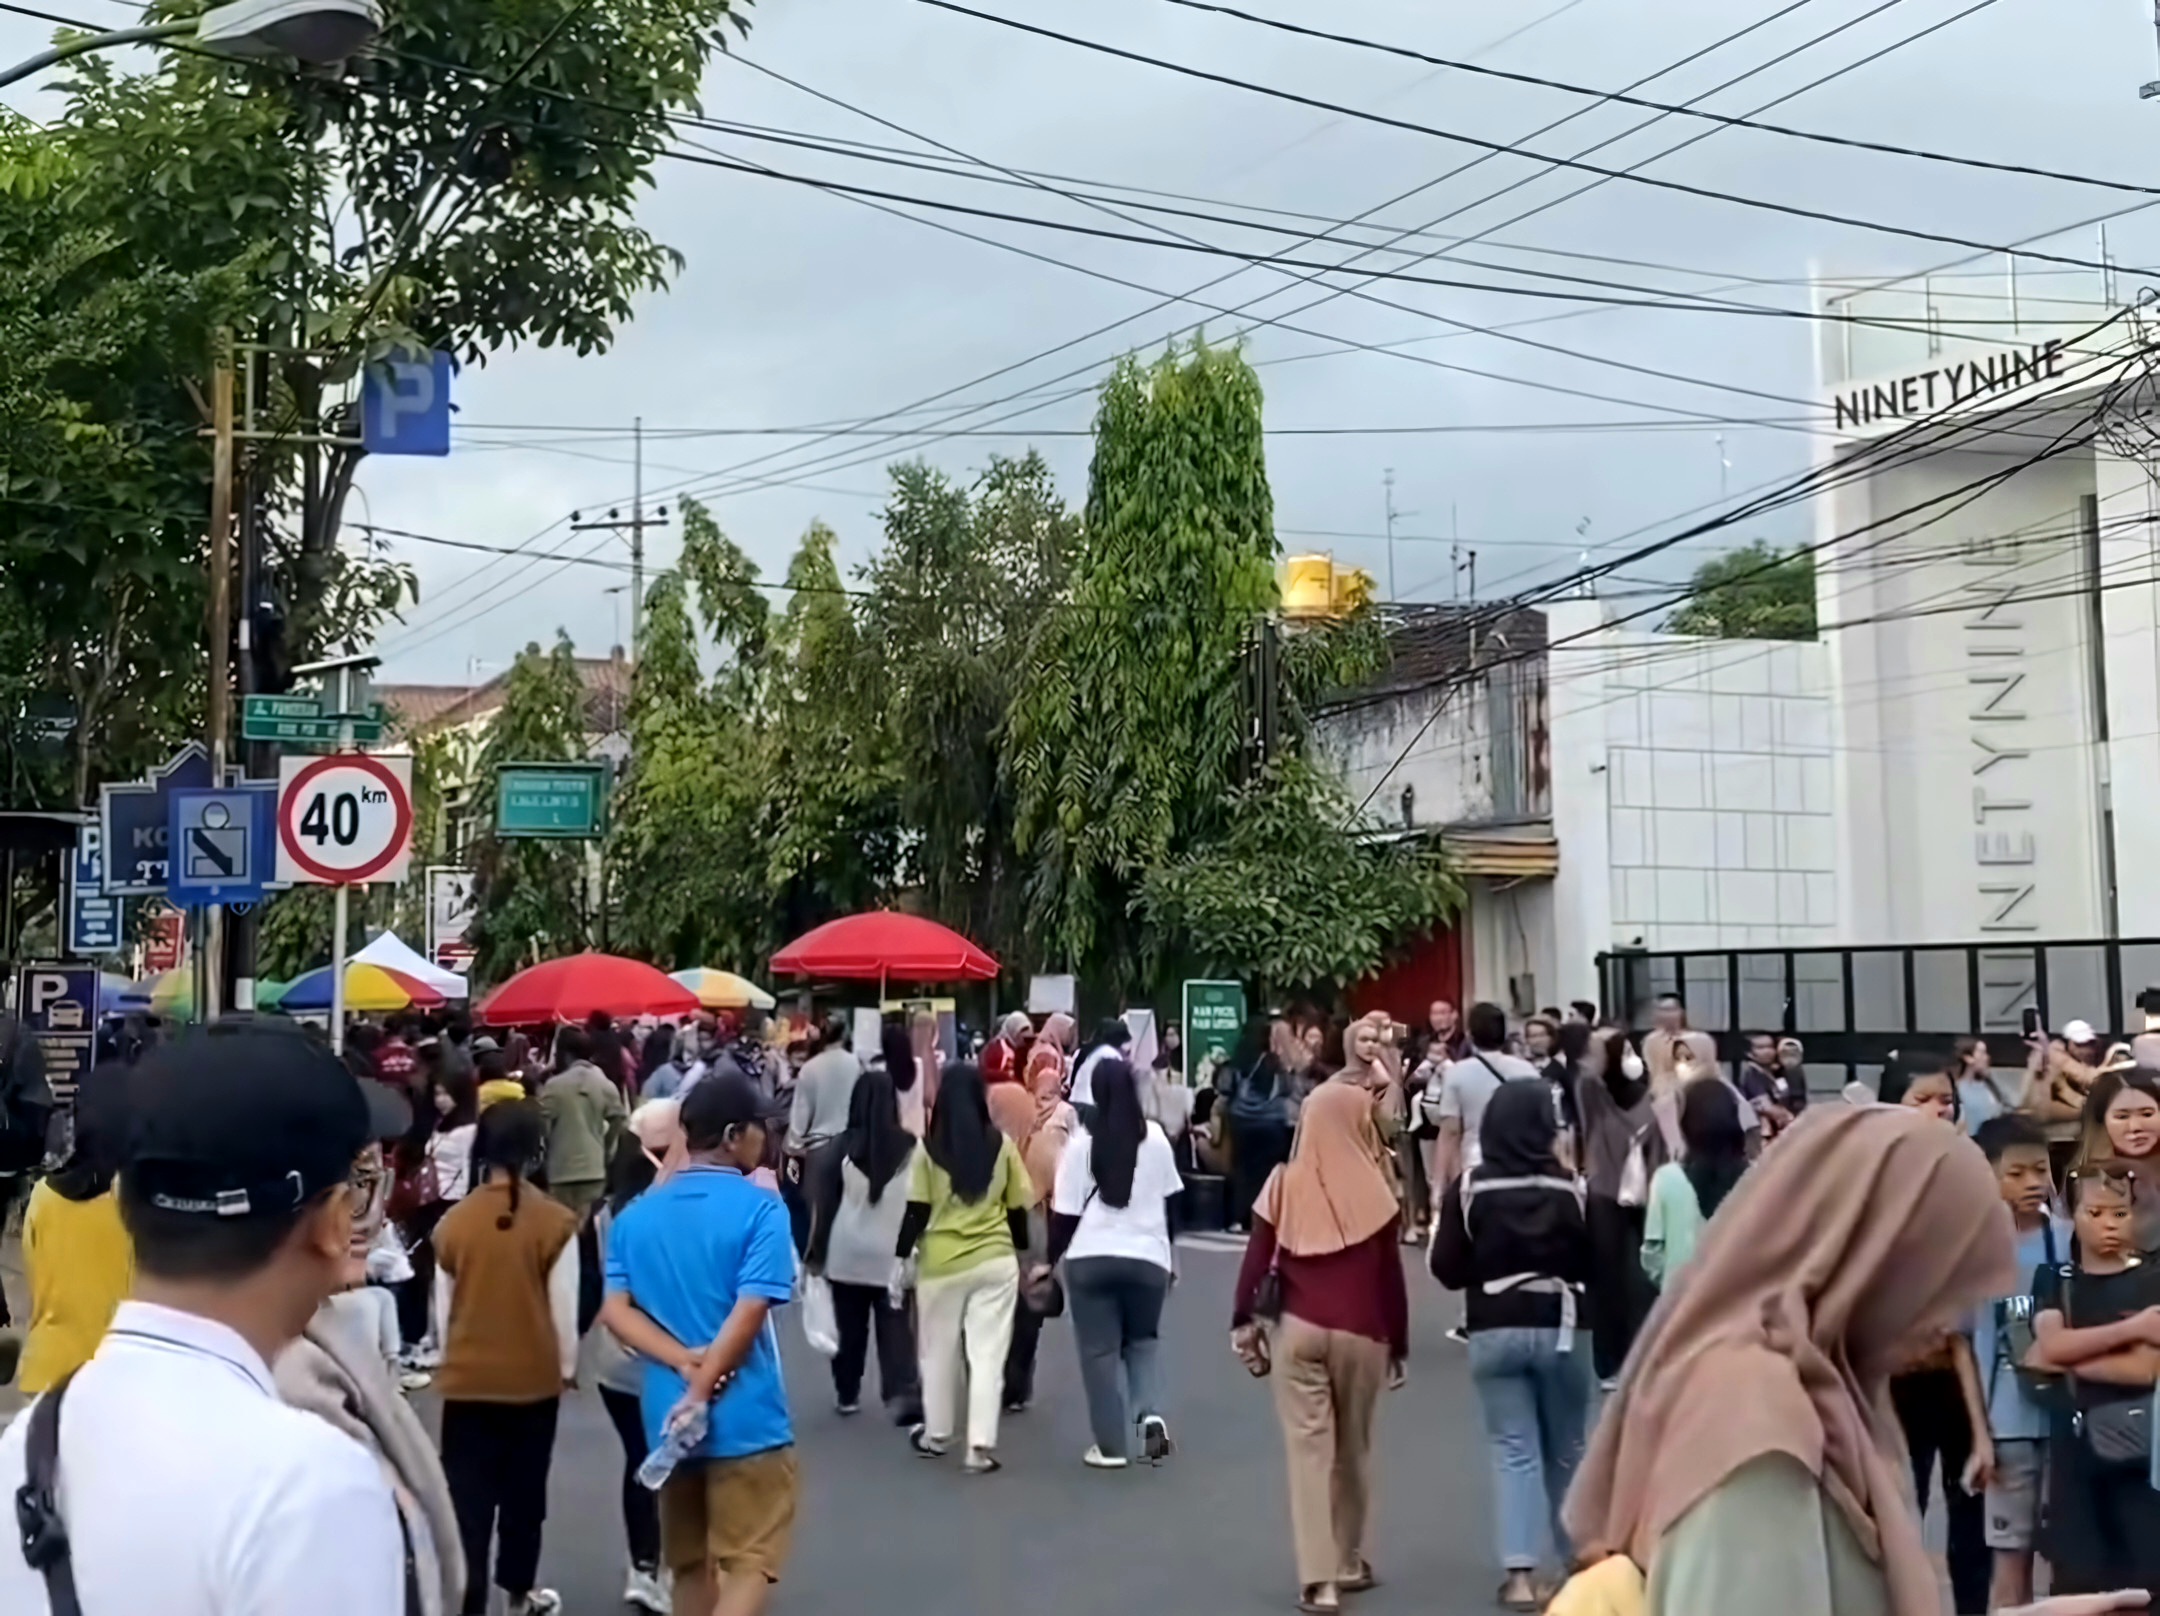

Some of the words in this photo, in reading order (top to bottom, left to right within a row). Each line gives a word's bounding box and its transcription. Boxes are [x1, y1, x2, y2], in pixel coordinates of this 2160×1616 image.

[381, 361, 434, 438] P
[1836, 338, 2063, 430] NINETYNINE
[300, 792, 359, 846] 40
[361, 785, 388, 803] km
[1962, 536, 2038, 1028] NINETYNINE
[32, 974, 69, 1013] P
